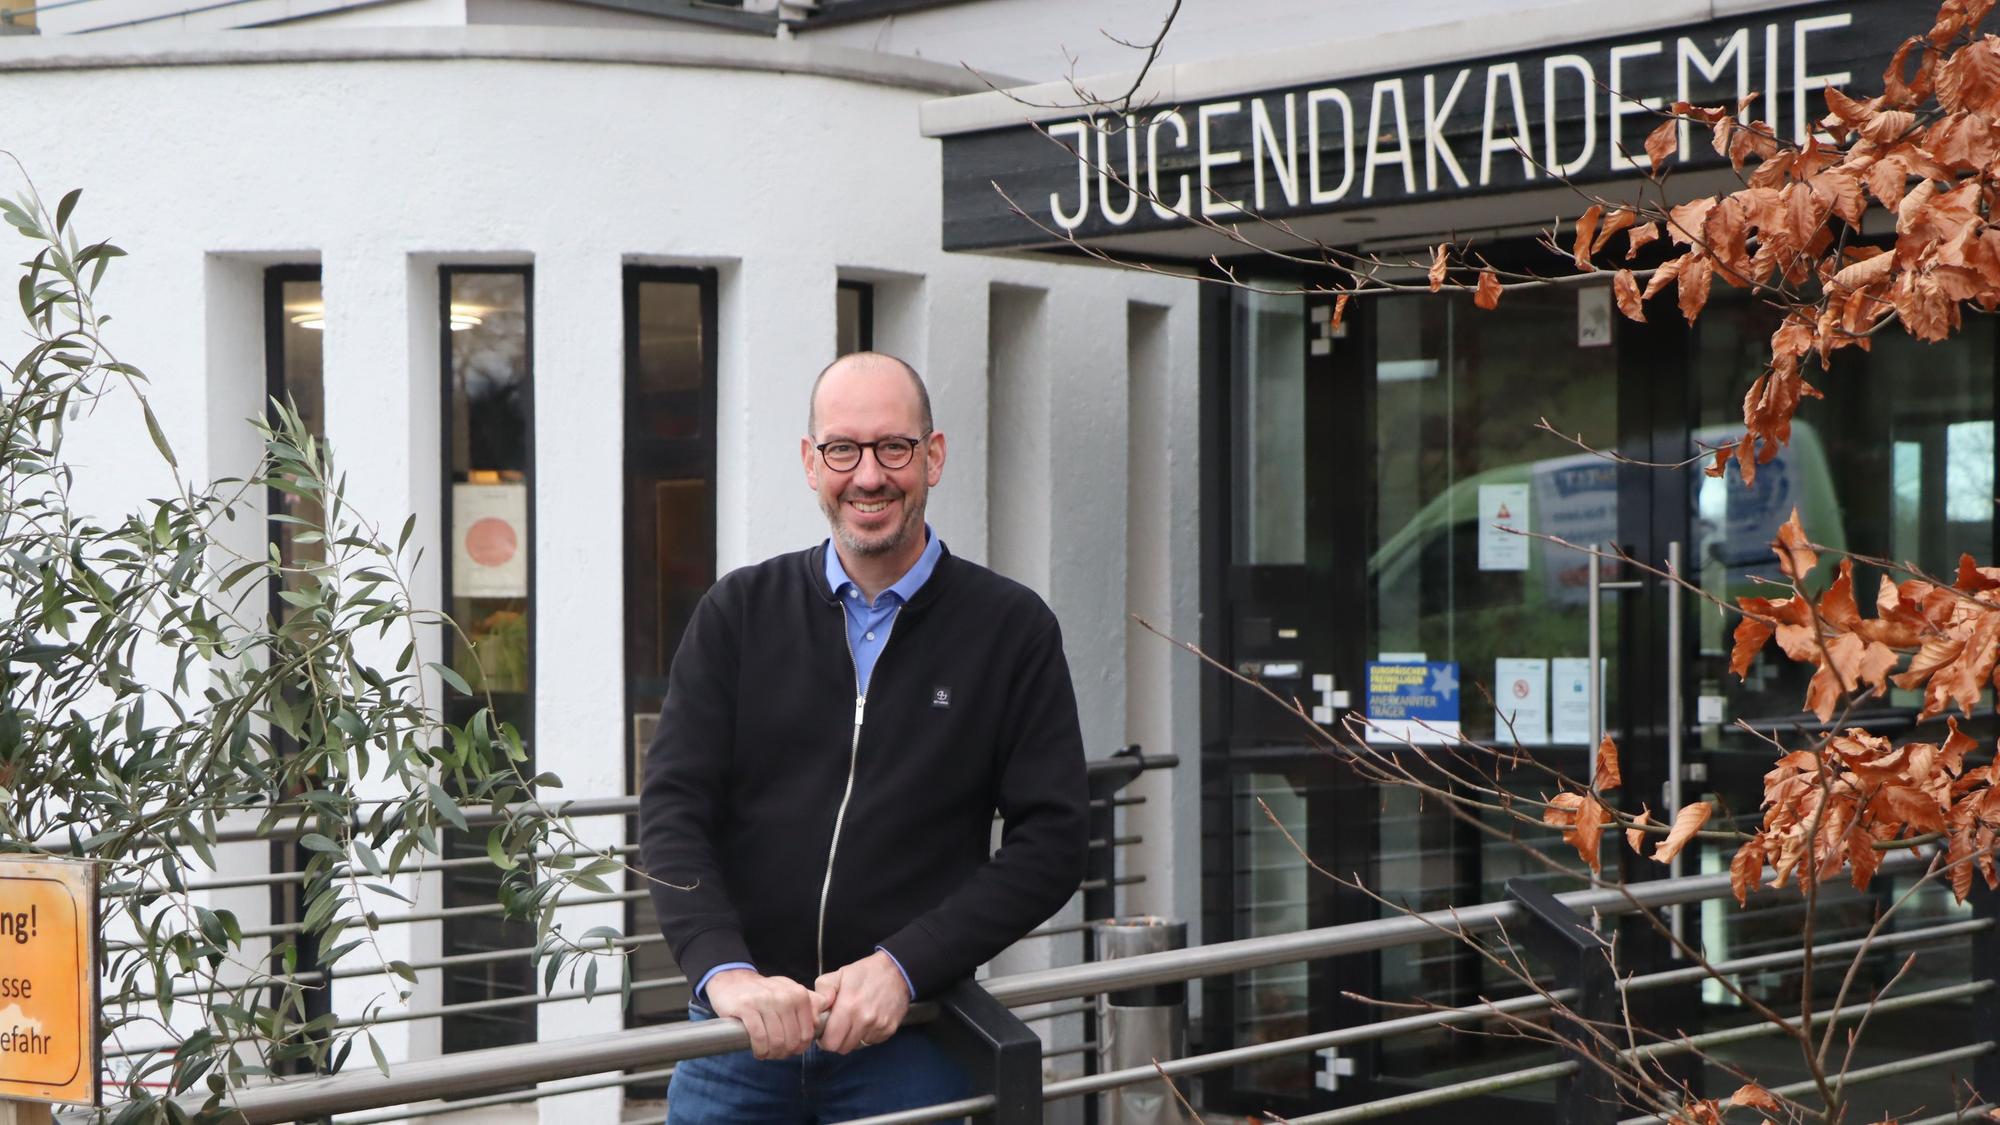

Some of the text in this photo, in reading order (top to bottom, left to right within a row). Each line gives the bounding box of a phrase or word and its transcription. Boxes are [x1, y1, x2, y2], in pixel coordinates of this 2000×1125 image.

[1048, 13, 1852, 229] JUGENDAKADEMIE
[1370, 684, 1397, 693] DIENST
[1370, 695, 1437, 707] ANERKANNTER
[1371, 705, 1405, 717] TRÄGER
[0, 904, 37, 945] ng!
[2, 976, 32, 999] sse
[0, 1025, 52, 1055] efahr
